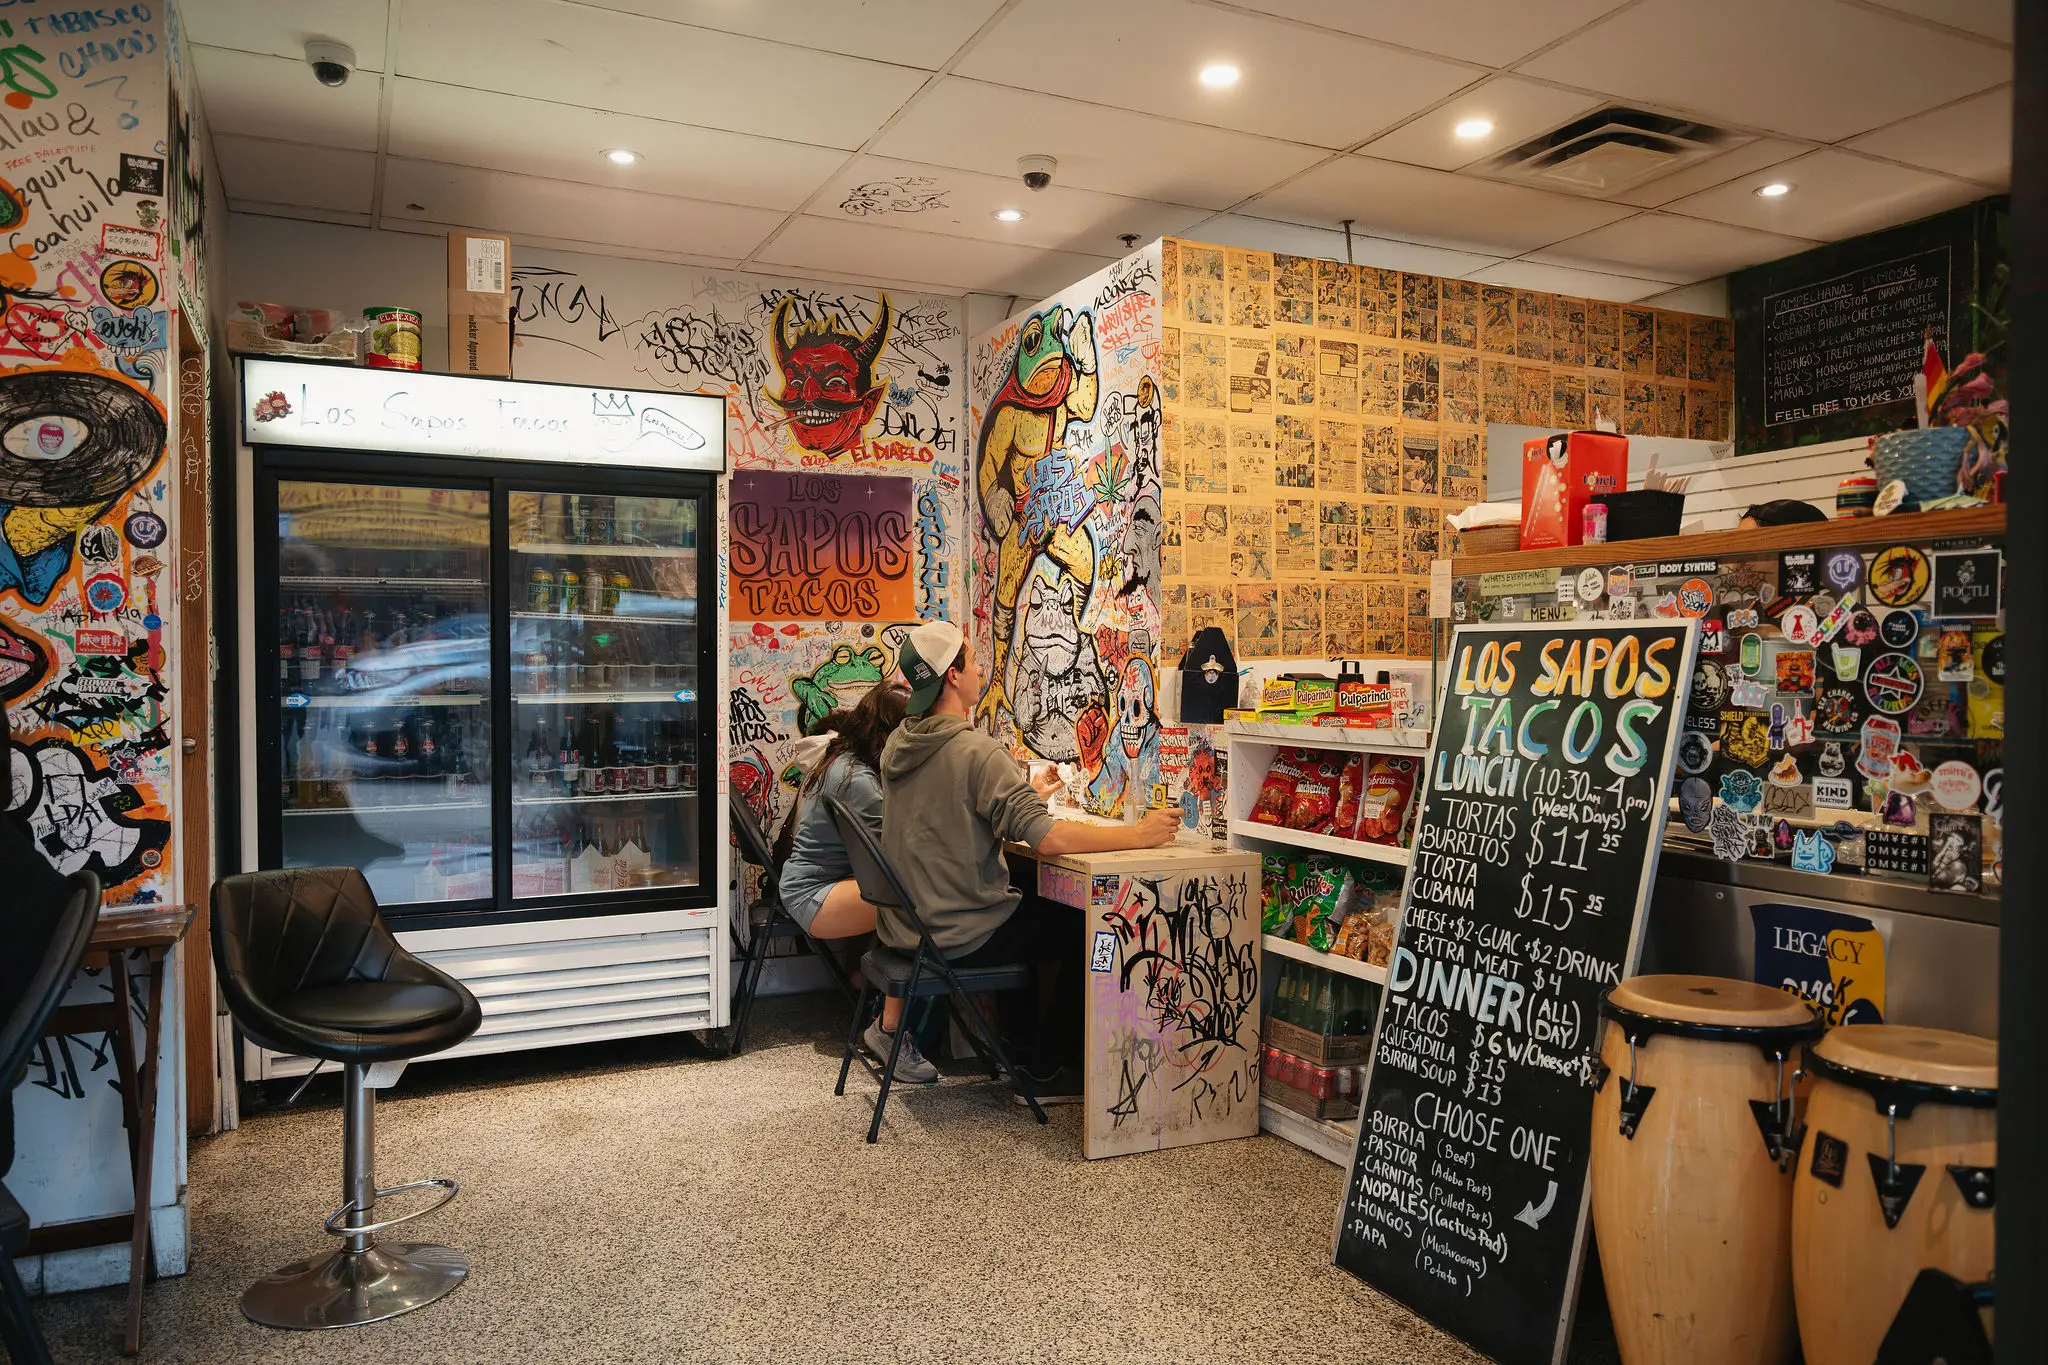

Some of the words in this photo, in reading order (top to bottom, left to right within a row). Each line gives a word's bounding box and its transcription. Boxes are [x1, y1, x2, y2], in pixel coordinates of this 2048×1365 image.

[379, 315, 389, 323] EL
[300, 384, 357, 427] Los
[381, 391, 467, 439] Sapos
[492, 399, 570, 434] Tacos
[1775, 408, 1811, 423] FEEL
[1811, 399, 1840, 416] FREE
[1843, 396, 1857, 410] TO
[1860, 389, 1892, 406] MAKE
[852, 445, 872, 463] EL
[874, 441, 935, 464] DIABLO
[787, 473, 842, 504] LOS
[729, 502, 913, 580] SAPOS
[1659, 562, 1683, 574] BODY
[1683, 561, 1717, 573] SYNTHS
[739, 578, 881, 617] TACOS
[1530, 607, 1561, 621] MENU
[1455, 641, 1522, 695] LOS
[1531, 635, 1677, 699] SAPOS
[1296, 686, 1334, 704] Pulparindo
[1339, 688, 1392, 707] Pulparindo
[1720, 711, 1744, 722] SHIELD
[1461, 698, 1664, 778] TACOS
[1434, 751, 1521, 797] LUNCH
[1816, 785, 1850, 798] KIND
[1441, 798, 1519, 841] TORTAS
[1422, 823, 1512, 868] BURRITOS
[1419, 851, 1479, 887] TORTA
[1411, 876, 1476, 911] CUBANA
[1404, 906, 1449, 934] CHEESE
[1556, 947, 1621, 986] DRINK
[1417, 932, 1465, 964] EXTRA
[1474, 949, 1523, 980] MEAT
[1773, 926, 1865, 966] LEGACY
[1389, 945, 1526, 1034] DINNER
[1391, 995, 1450, 1038] TACOS
[1384, 1024, 1456, 1066] QUESADILLA
[1380, 1046, 1418, 1074] BIRRIA
[1421, 1060, 1457, 1087] SOUP
[1372, 1110, 1426, 1151] BIRRIA
[1414, 1091, 1505, 1152] CHOOSE
[1509, 1126, 1561, 1172] ONE
[1368, 1134, 1418, 1173] PASTOR
[1364, 1154, 1424, 1197] CARNITAS
[1357, 1195, 1413, 1239] HONGOS
[1360, 1174, 1429, 1223] NOPALES
[1354, 1218, 1388, 1250] PAPA
